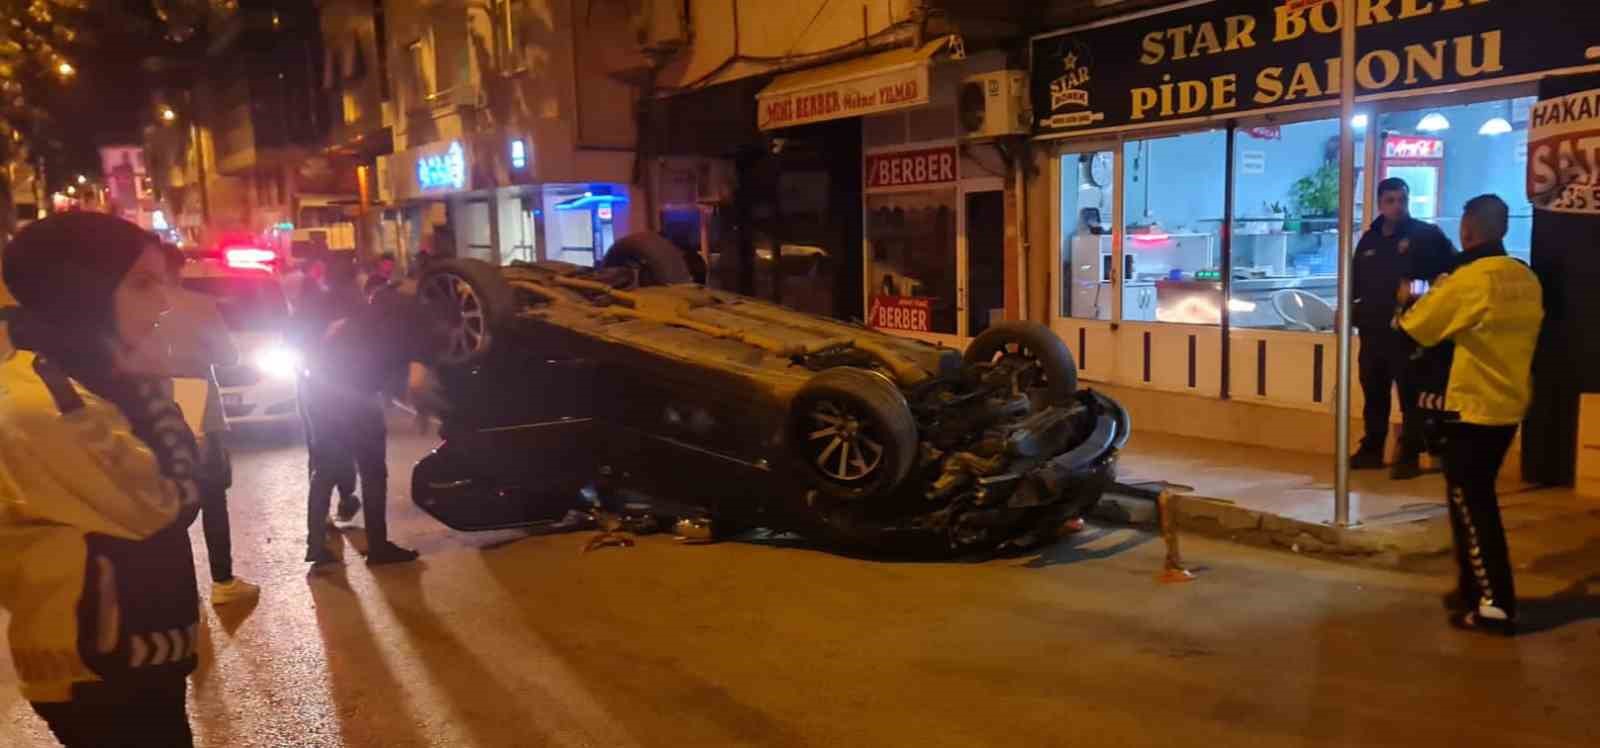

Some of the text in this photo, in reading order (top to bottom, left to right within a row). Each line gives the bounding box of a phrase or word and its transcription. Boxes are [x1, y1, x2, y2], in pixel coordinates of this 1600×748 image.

[1139, 14, 1257, 65] STAR
[796, 91, 841, 119] BERBER
[1129, 73, 1238, 119] PİDE
[880, 153, 953, 184] BERBER
[879, 306, 928, 331] BERBER
